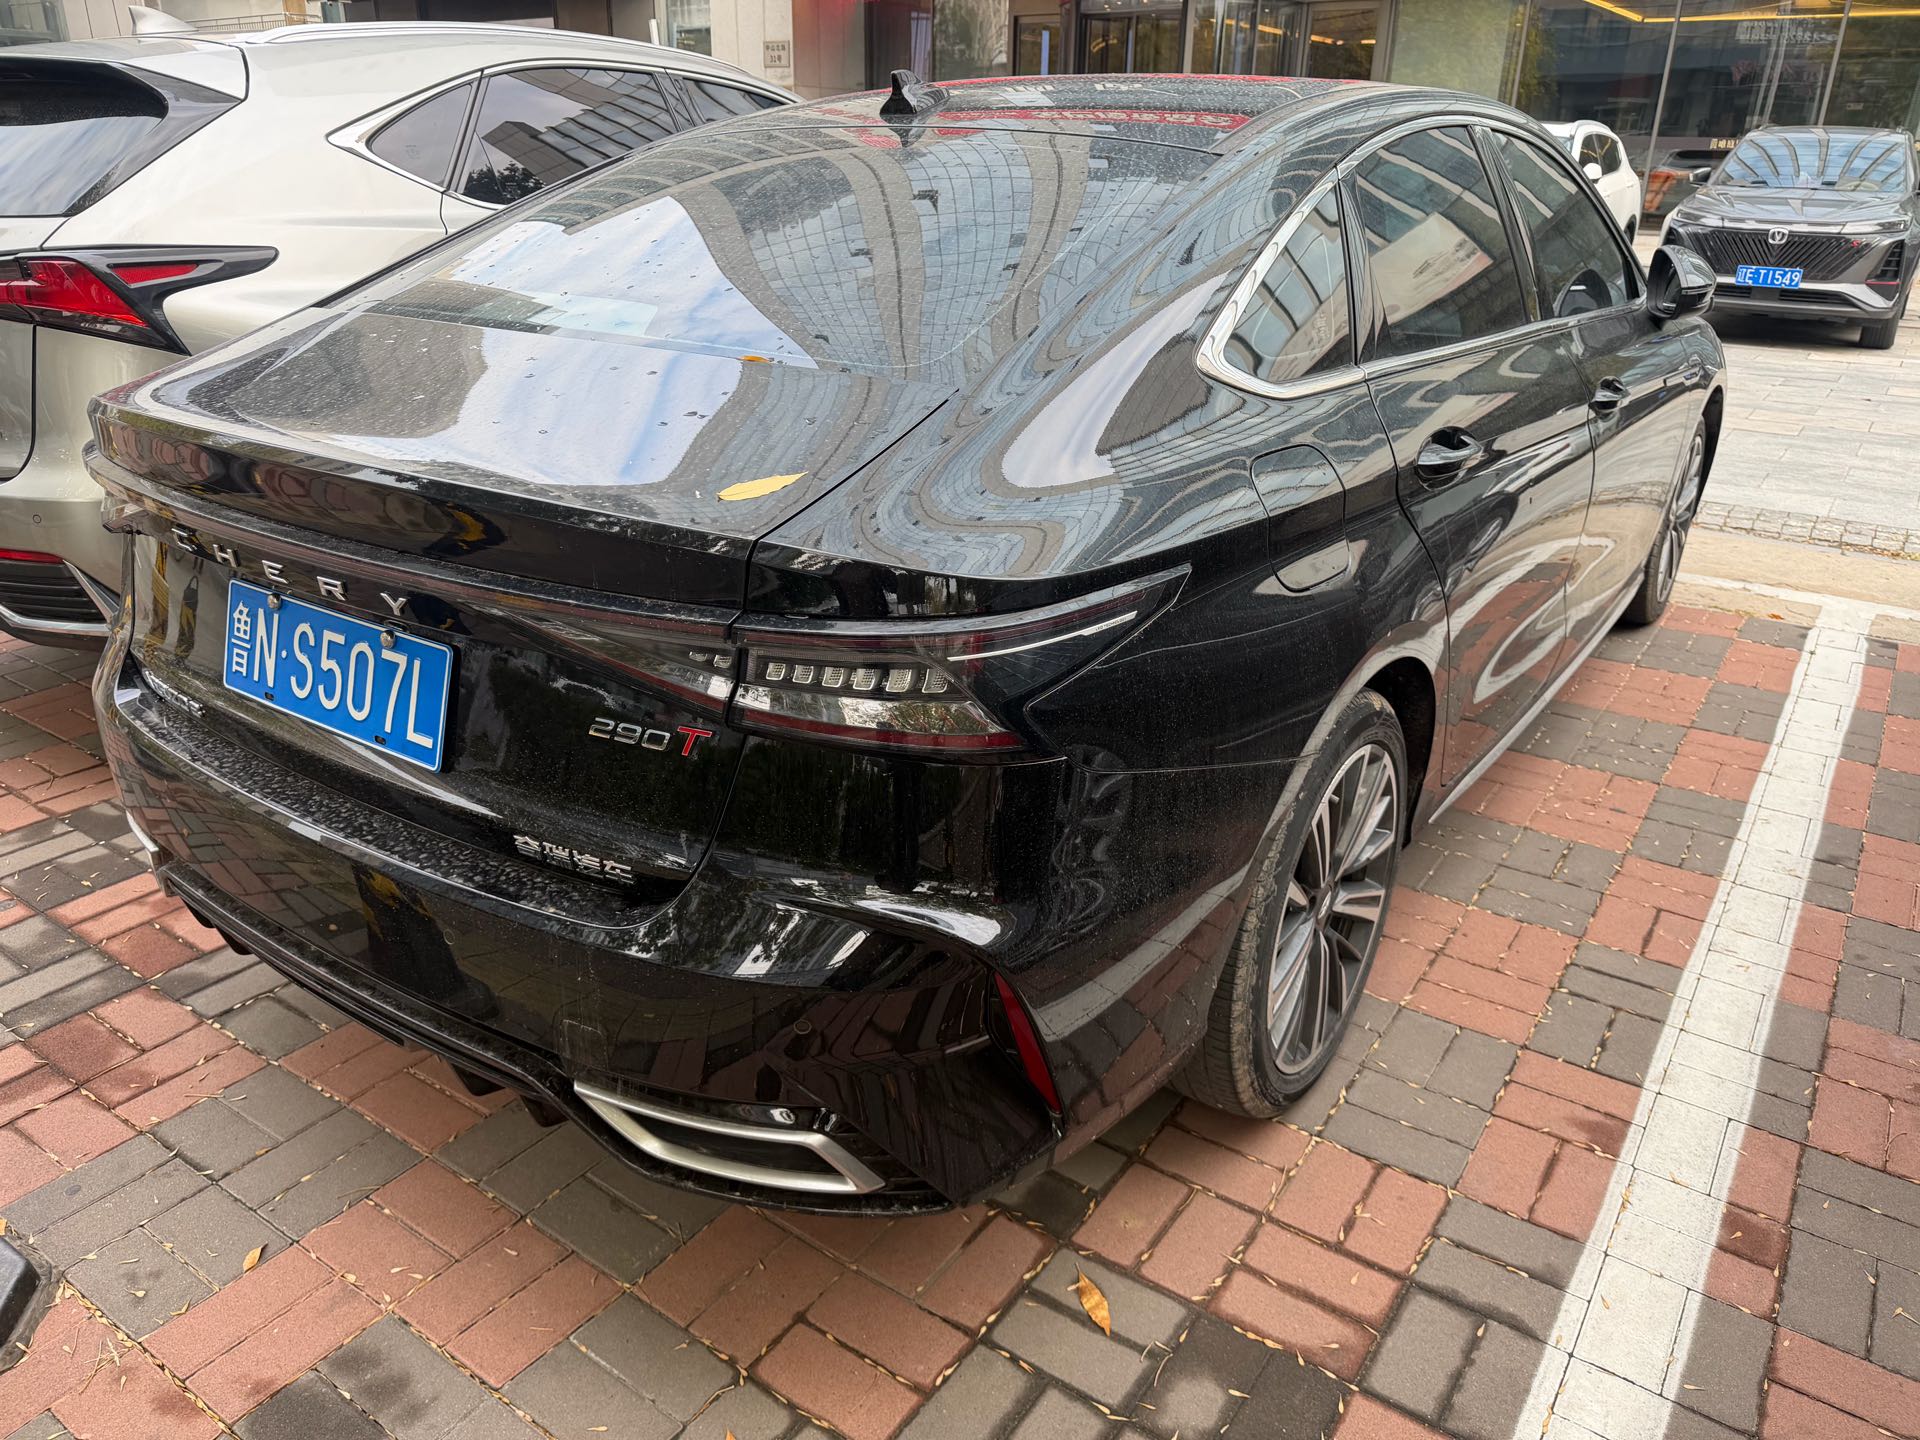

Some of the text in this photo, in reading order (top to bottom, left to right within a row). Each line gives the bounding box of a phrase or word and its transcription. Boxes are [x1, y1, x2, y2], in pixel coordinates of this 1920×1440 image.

[171, 526, 407, 616] CHERY
[231, 601, 433, 749] 鲁N·S507L
[588, 717, 713, 756] 290T
